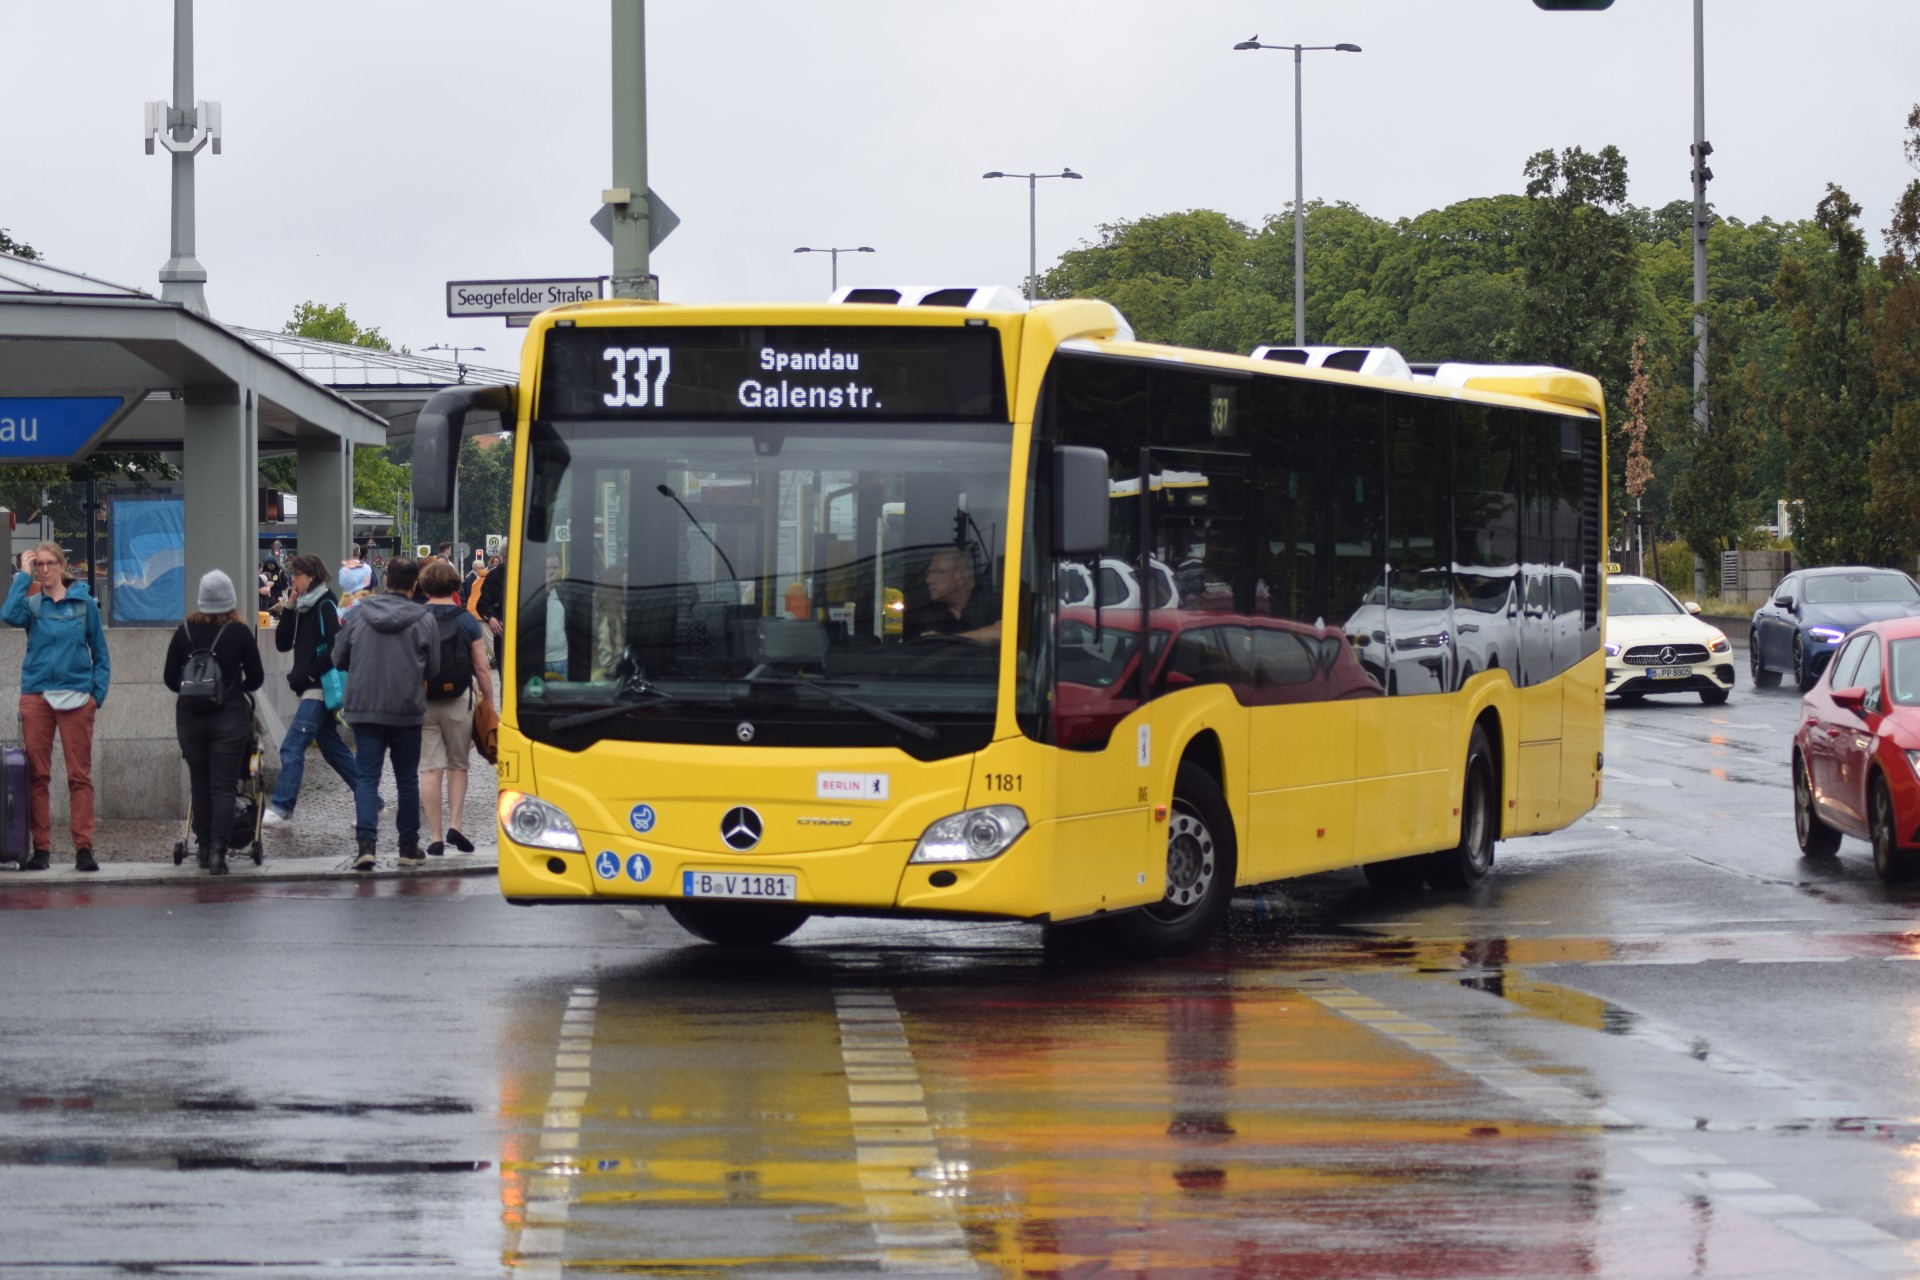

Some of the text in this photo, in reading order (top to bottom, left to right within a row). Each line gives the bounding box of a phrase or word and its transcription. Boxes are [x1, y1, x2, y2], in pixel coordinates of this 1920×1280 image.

[457, 286, 593, 309] Seegefelder Straße
[760, 347, 859, 371] Spandau
[603, 347, 670, 407] 337
[738, 380, 882, 408] Galenstr.
[1661, 669, 1672, 677] PP
[822, 780, 861, 791] BERLIN
[985, 773, 1022, 792] 1181
[701, 875, 788, 897] B V 1181
